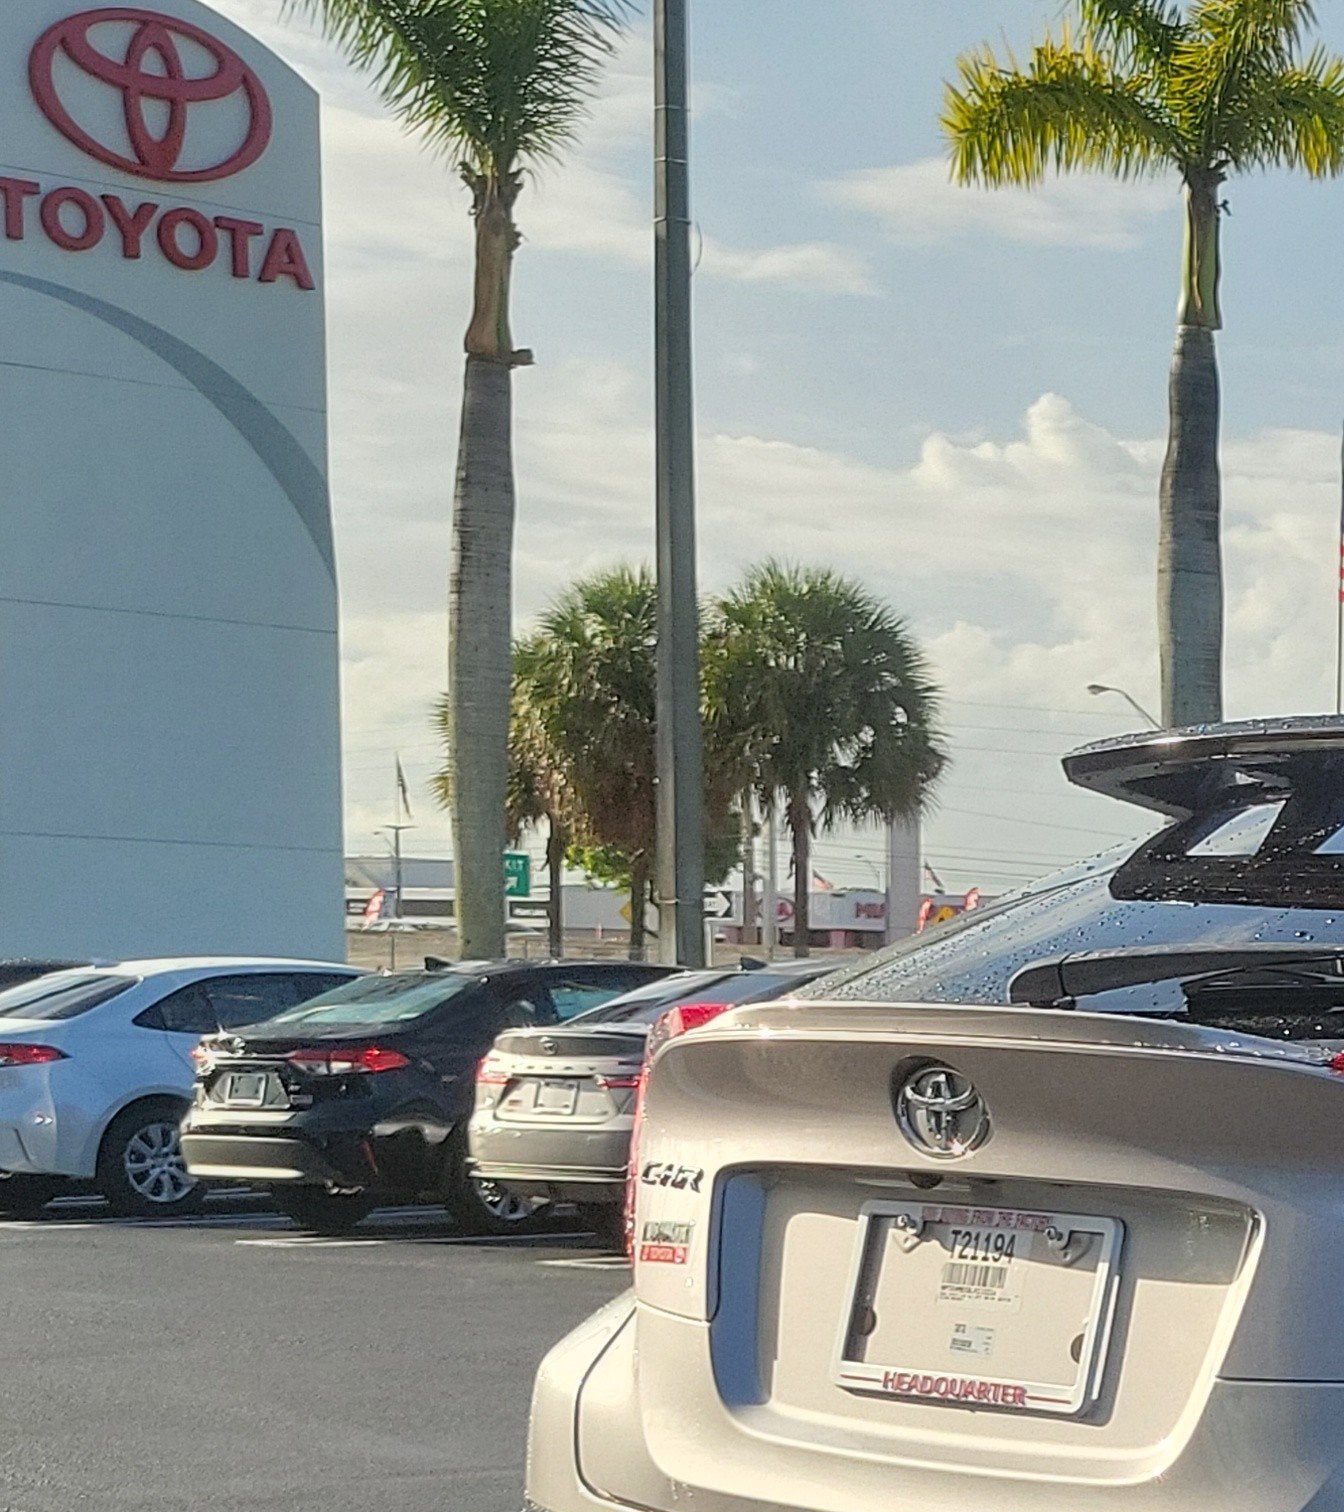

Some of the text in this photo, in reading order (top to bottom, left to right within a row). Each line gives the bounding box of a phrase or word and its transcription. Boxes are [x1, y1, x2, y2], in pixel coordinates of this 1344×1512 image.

[0, 176, 315, 291] TOYOTA
[950, 1229, 1016, 1263] T21194
[882, 1371, 1027, 1406] HEADQUARTER
